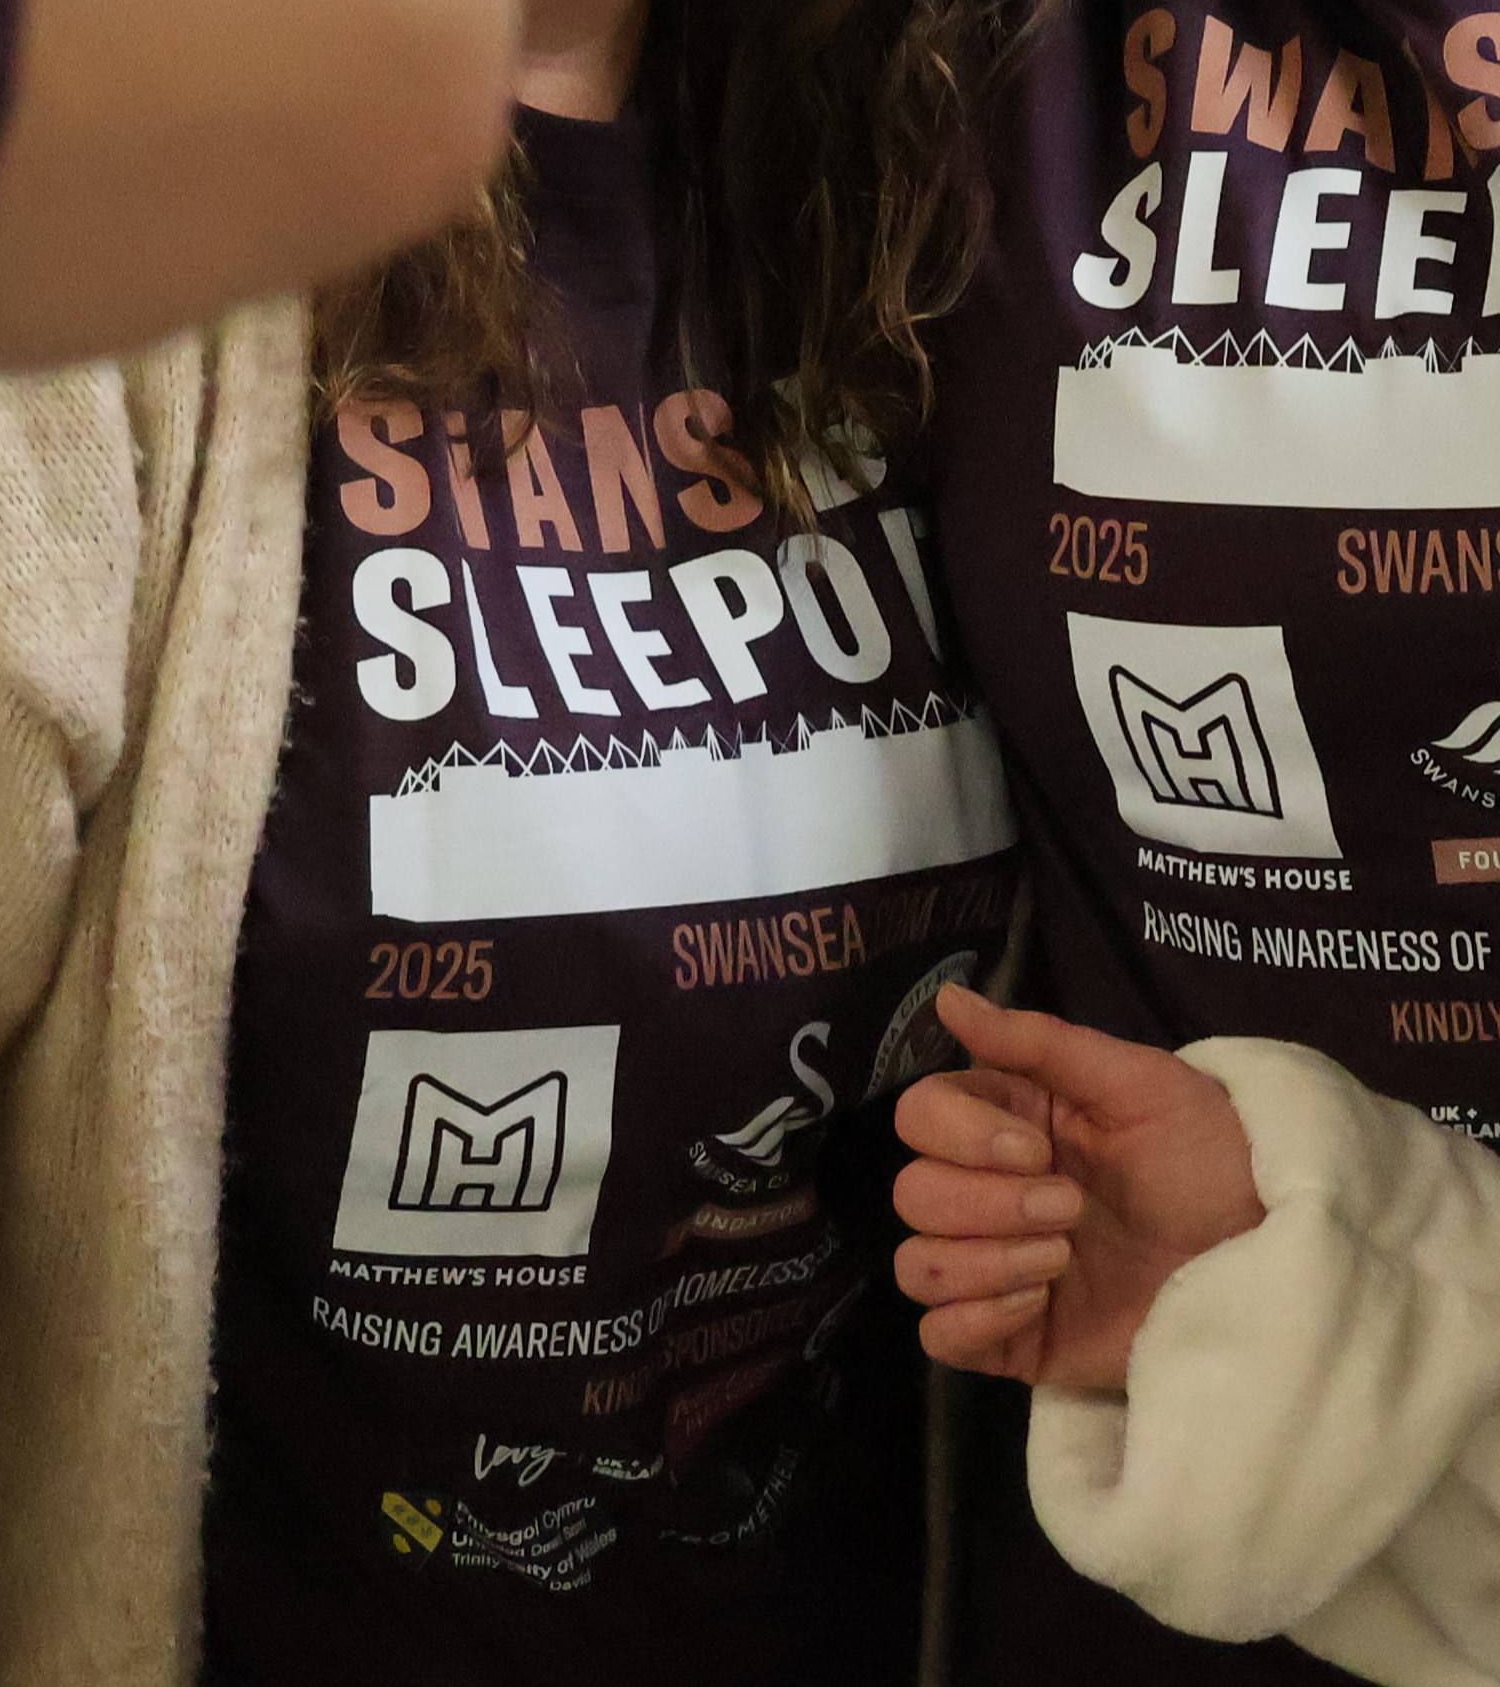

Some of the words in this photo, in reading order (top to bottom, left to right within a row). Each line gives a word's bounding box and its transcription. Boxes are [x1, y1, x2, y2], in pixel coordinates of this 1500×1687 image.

[1049, 513, 1149, 585] 2025
[1138, 847, 1256, 889] MATTHEW'S
[1264, 867, 1353, 892] HOUSE
[1143, 900, 1241, 962] RAISING
[1252, 926, 1441, 972] AWARENESS
[1451, 929, 1491, 972] OF
[364, 939, 494, 1001] 2025
[1431, 1106, 1460, 1122] UK
[328, 1259, 486, 1287] MATTHEW'S
[495, 1265, 588, 1287] HOUSE
[312, 1295, 443, 1356] RAISING
[451, 1309, 643, 1359] AWARENESS
